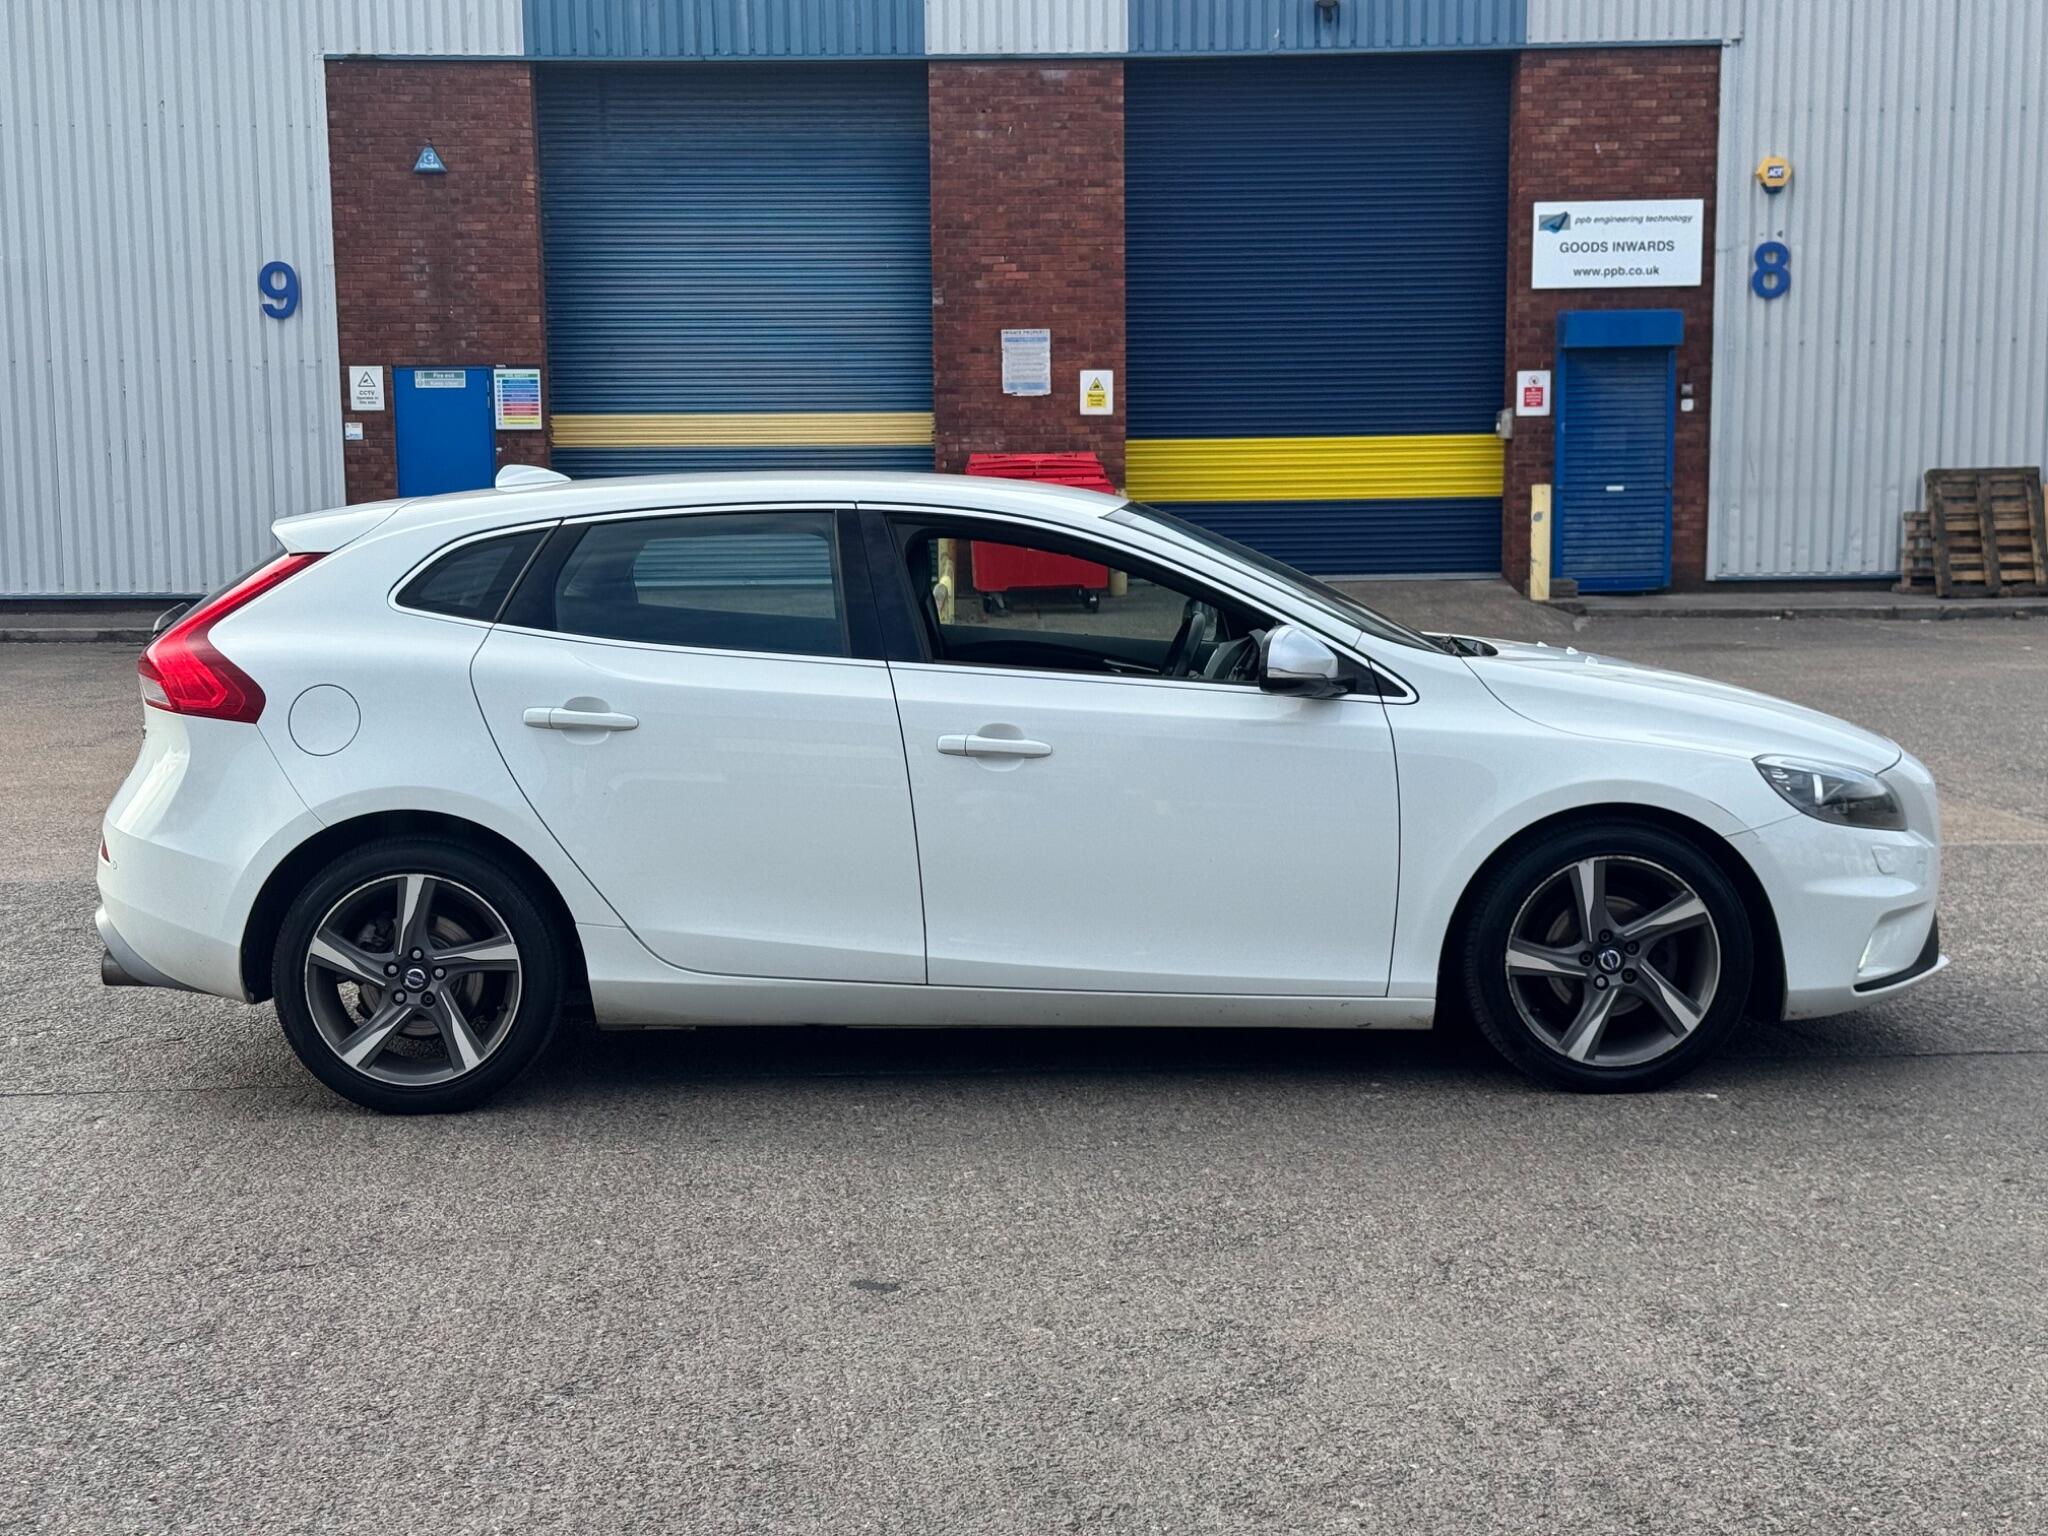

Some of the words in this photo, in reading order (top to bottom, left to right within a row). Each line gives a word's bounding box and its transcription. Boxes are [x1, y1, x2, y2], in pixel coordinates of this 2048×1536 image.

[1574, 215, 1591, 225] ppb
[1593, 214, 1644, 225] engineering
[1645, 213, 1693, 224] technology
[1559, 241, 1608, 254] GOODS
[1612, 240, 1675, 253] INWARDS
[1573, 266, 1660, 279] www.ppb.co.uk
[1752, 241, 1791, 299] 8
[259, 261, 298, 319] 9
